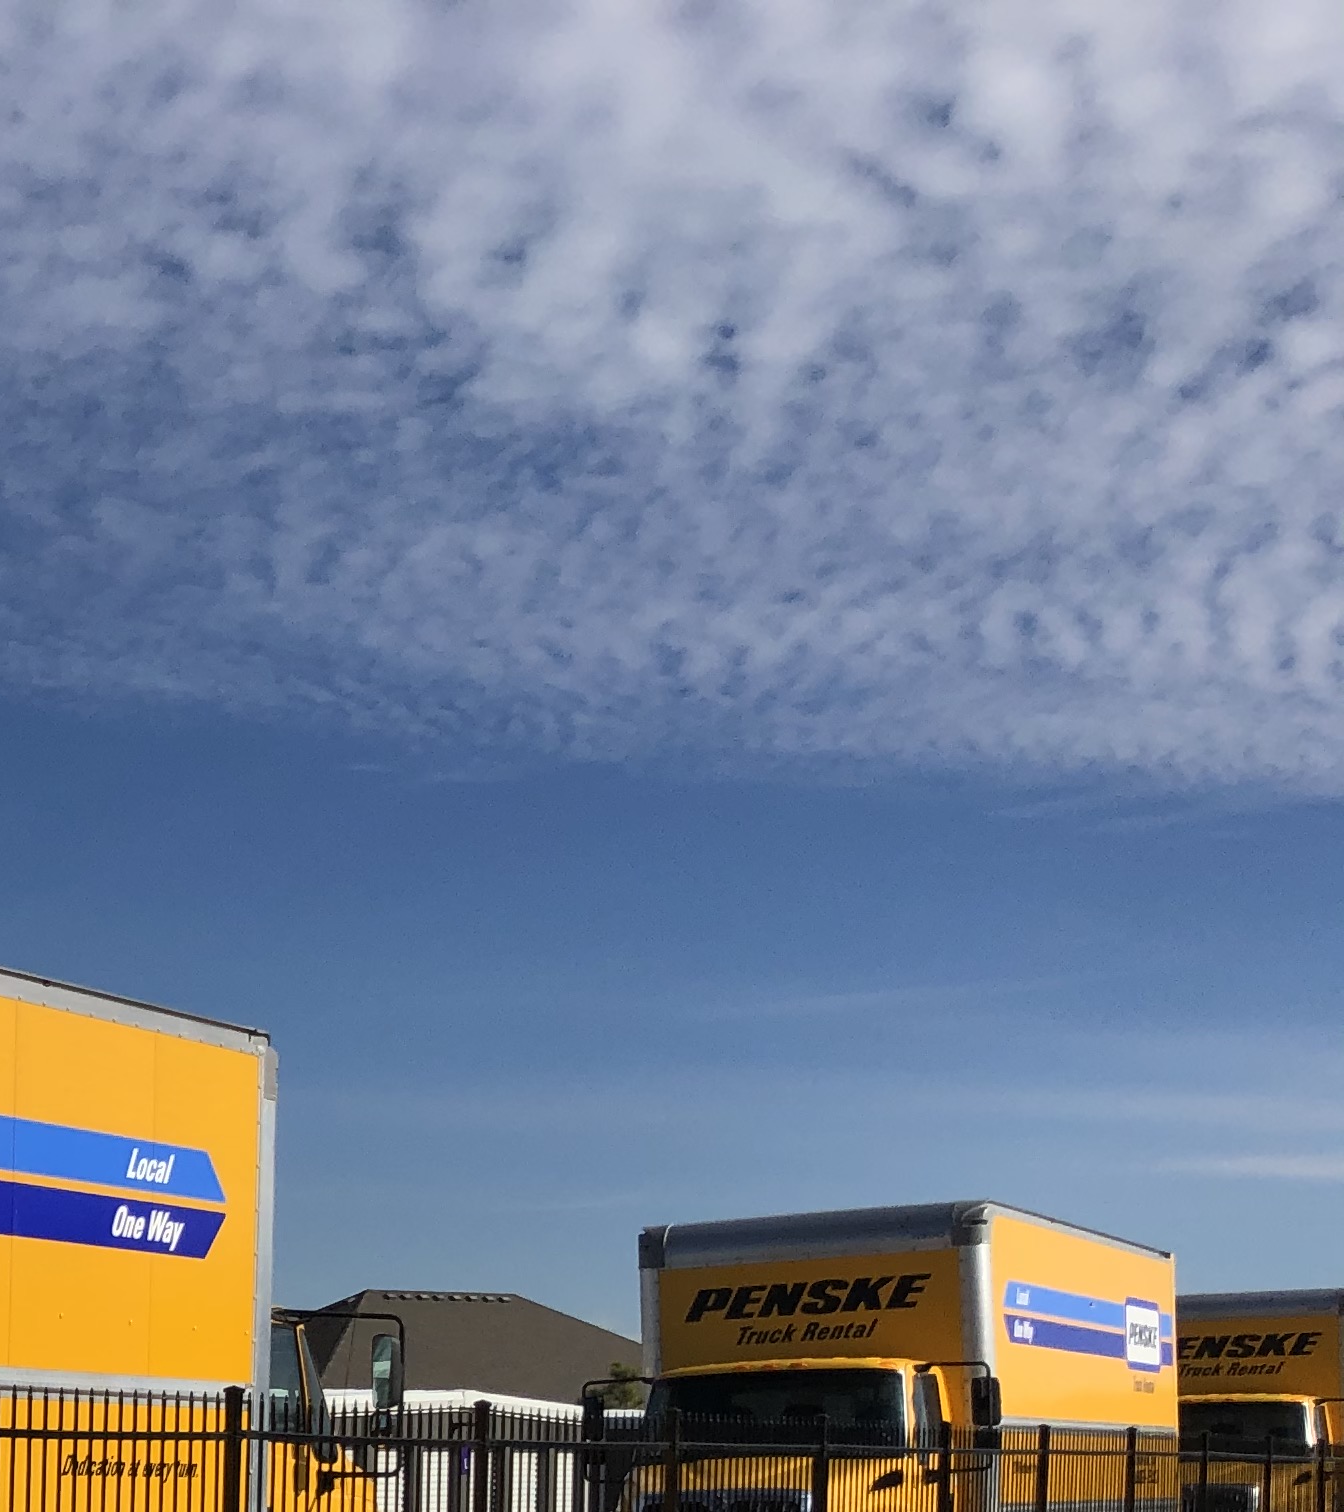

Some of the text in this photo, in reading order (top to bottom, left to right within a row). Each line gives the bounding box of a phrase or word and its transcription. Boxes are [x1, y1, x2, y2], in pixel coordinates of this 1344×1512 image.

[126, 1147, 173, 1186] Local
[111, 1203, 184, 1252] One Way
[685, 1273, 931, 1323] PENSKE
[736, 1318, 877, 1347] Truck Rental
[1177, 1331, 1323, 1360] ENSKE
[1179, 1361, 1286, 1378] Truck Rental
[61, 1454, 125, 1477] Ddcation
